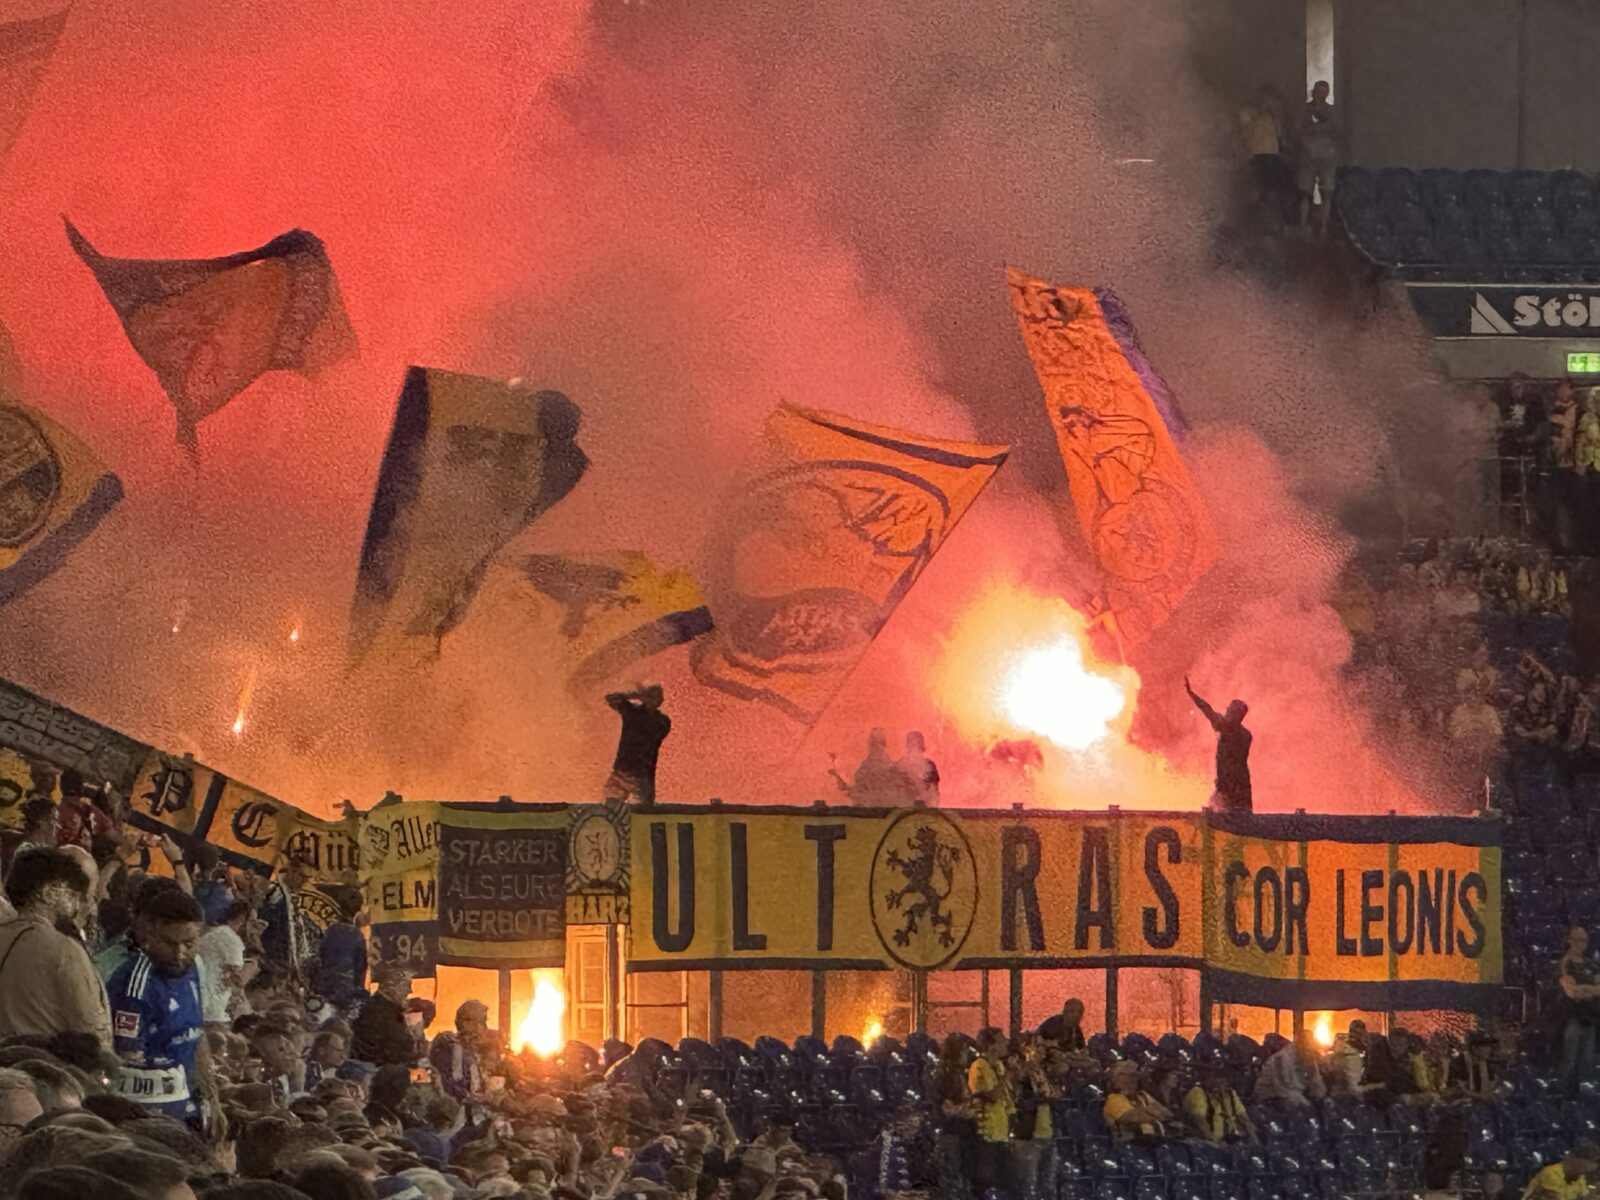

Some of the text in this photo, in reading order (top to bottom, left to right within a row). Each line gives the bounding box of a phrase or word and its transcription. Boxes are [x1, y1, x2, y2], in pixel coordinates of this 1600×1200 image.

[650, 821, 1182, 953] ULTRAS
[1224, 860, 1488, 959] COR LEONIS
